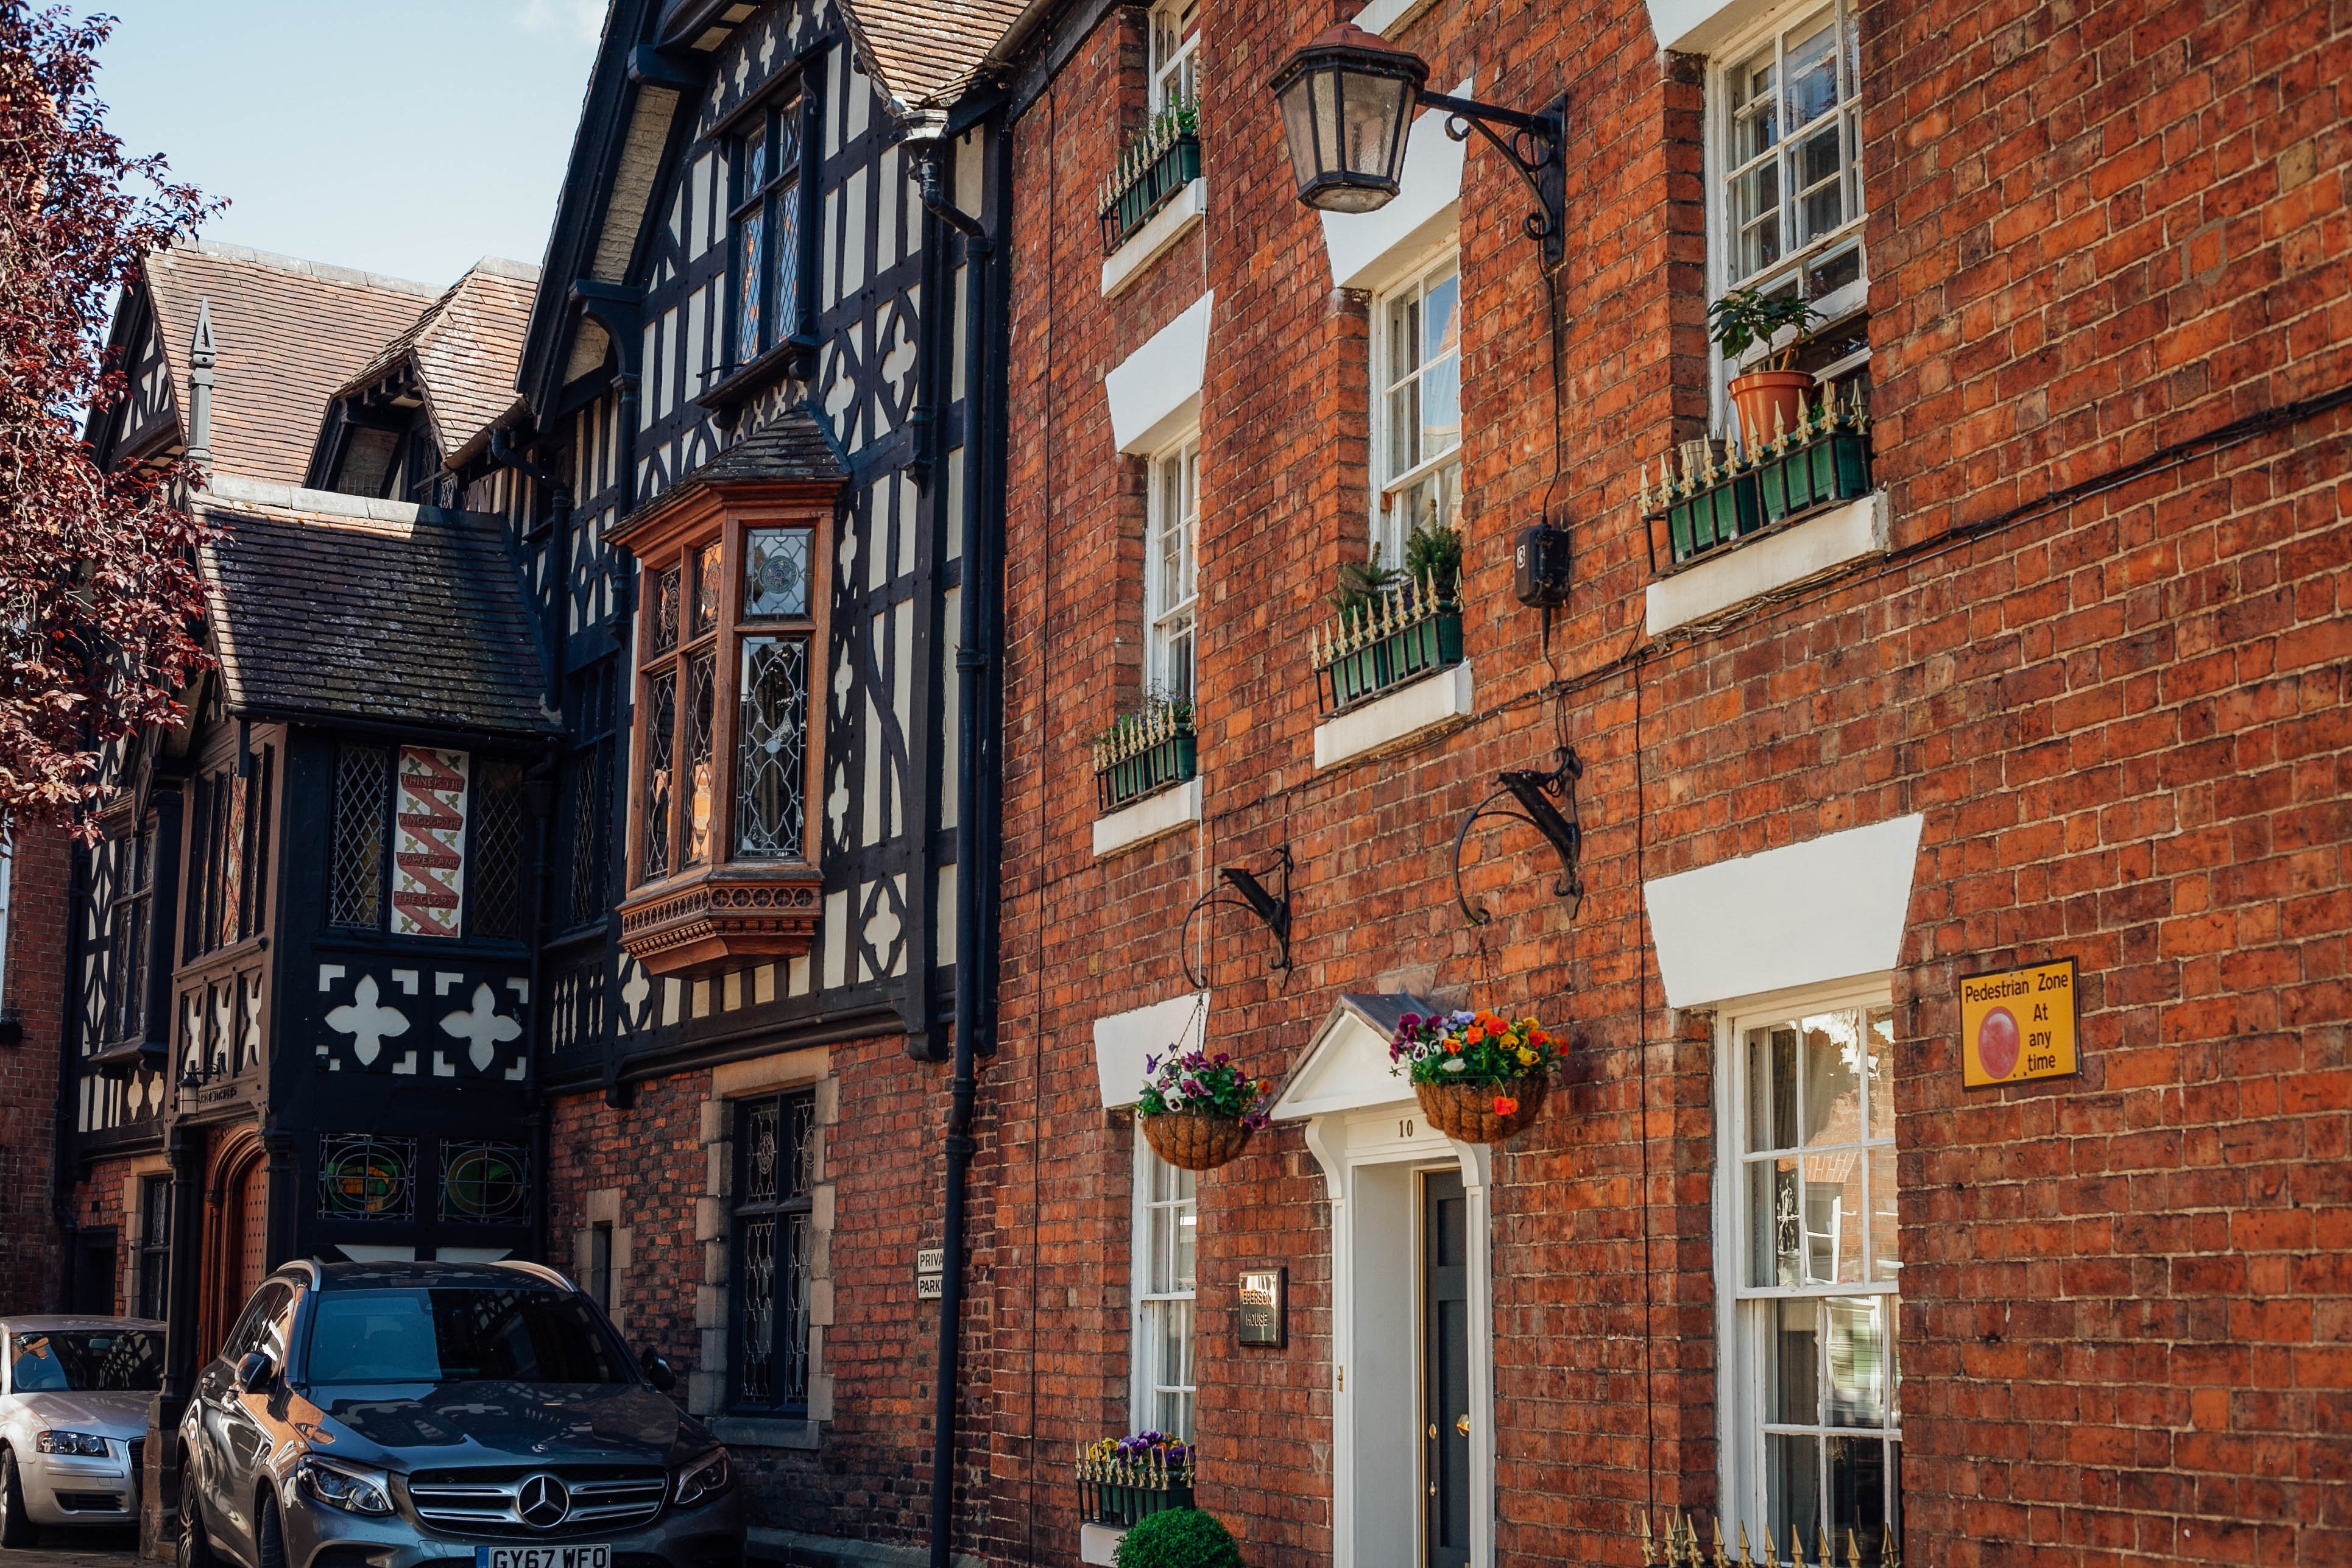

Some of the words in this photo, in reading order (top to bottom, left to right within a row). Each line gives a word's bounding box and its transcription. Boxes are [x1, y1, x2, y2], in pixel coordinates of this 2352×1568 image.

[401, 774, 433, 786] THINE
[434, 779, 442, 788] IS
[443, 780, 463, 790] THE
[444, 818, 462, 828] THE
[399, 853, 435, 865] POWER
[439, 858, 459, 868] AND
[395, 893, 417, 905] THE
[1965, 980, 2029, 1003] Pedestrian
[2038, 973, 2068, 992] Zone
[2033, 1003, 2049, 1022] At
[2029, 1031, 2052, 1049] any
[2028, 1054, 2056, 1072] time
[1399, 1119, 1413, 1137] 10
[1243, 1291, 1272, 1306] EPERSON
[1246, 1313, 1268, 1327] HOUSE
[493, 1549, 556, 1568] GY67
